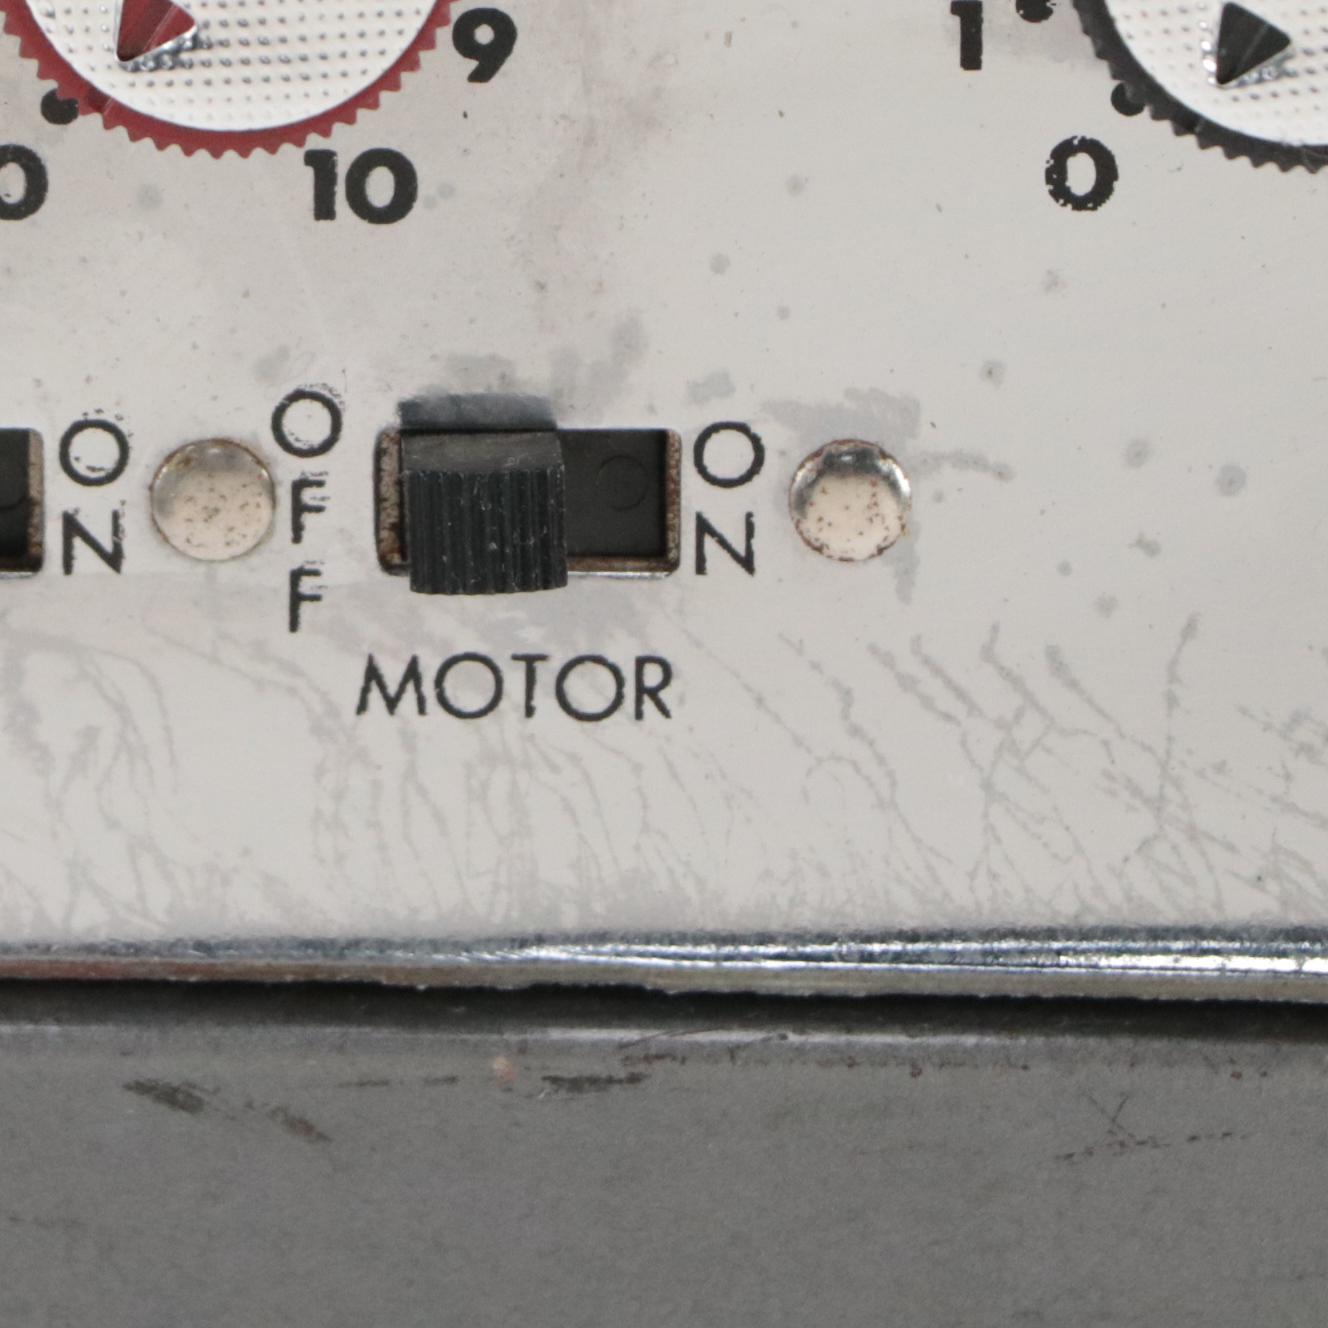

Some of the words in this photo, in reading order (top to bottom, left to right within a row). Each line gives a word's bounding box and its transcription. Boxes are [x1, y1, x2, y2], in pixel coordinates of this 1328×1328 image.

[452, 7, 517, 84] 9
[950, 0, 984, 72] 1
[304, 148, 419, 225] 10
[1044, 135, 1119, 212] 0
[59, 410, 130, 575] ON
[272, 386, 343, 633] OFF
[693, 421, 766, 576] ON
[356, 653, 673, 721] MOTOR
